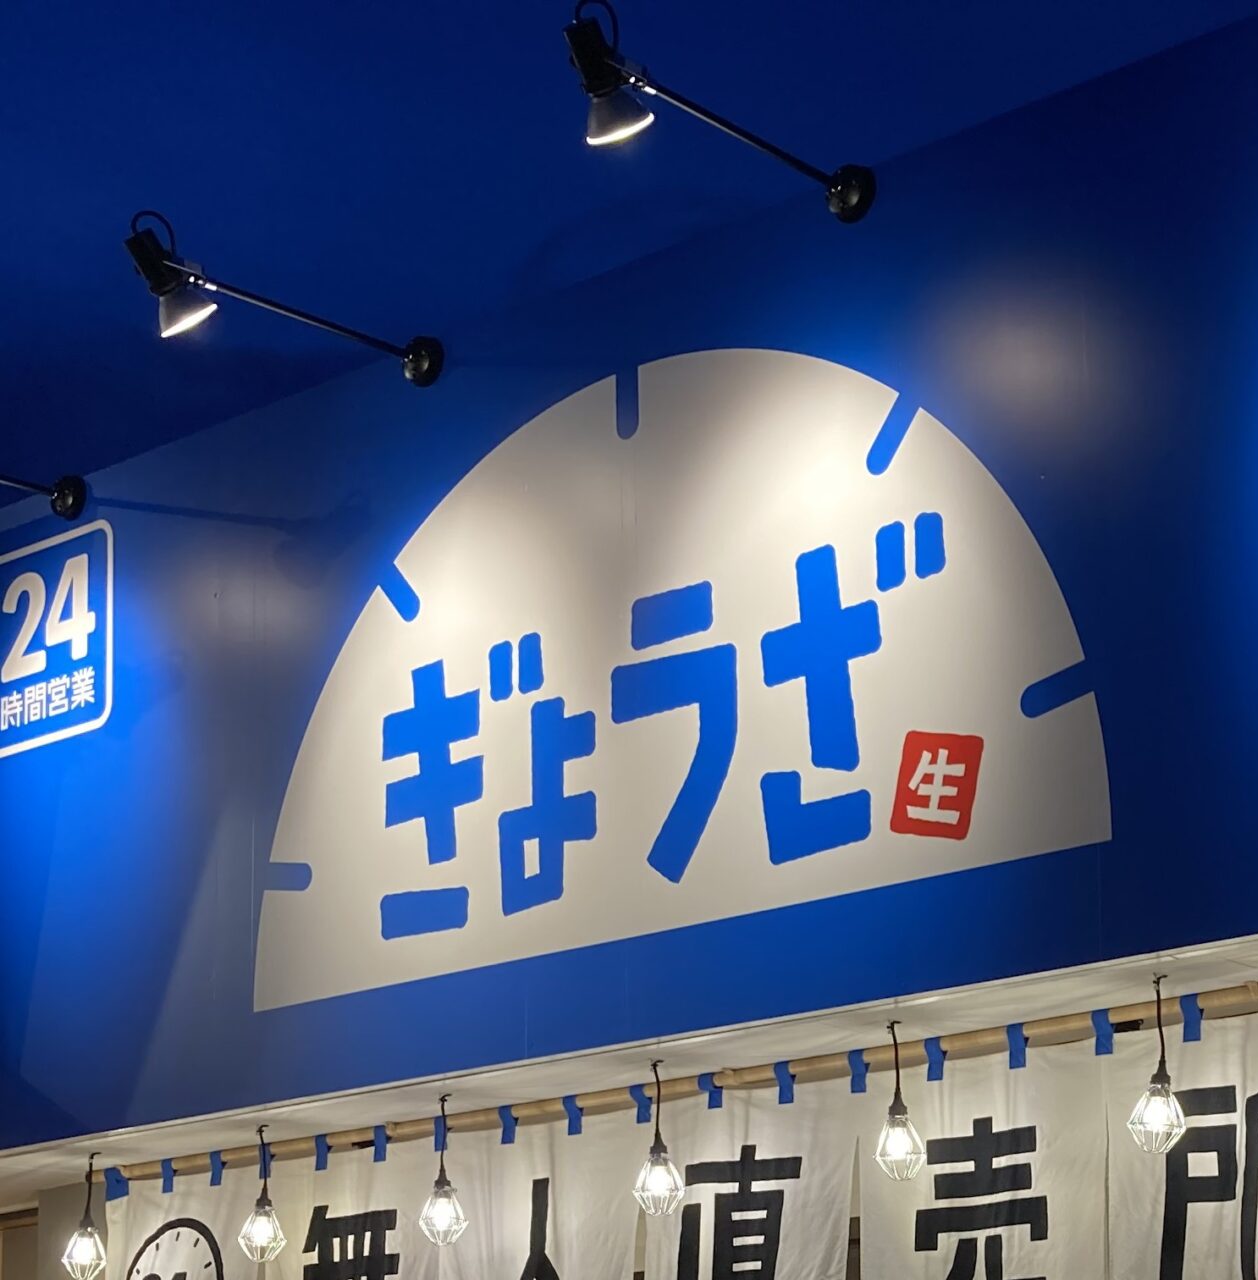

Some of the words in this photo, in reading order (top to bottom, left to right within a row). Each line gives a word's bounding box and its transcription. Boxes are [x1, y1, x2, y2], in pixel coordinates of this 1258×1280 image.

[2, 552, 96, 684] 24
[0, 666, 95, 732] 時間営業
[380, 512, 946, 941] ぎょうざ
[905, 748, 960, 825] 生
